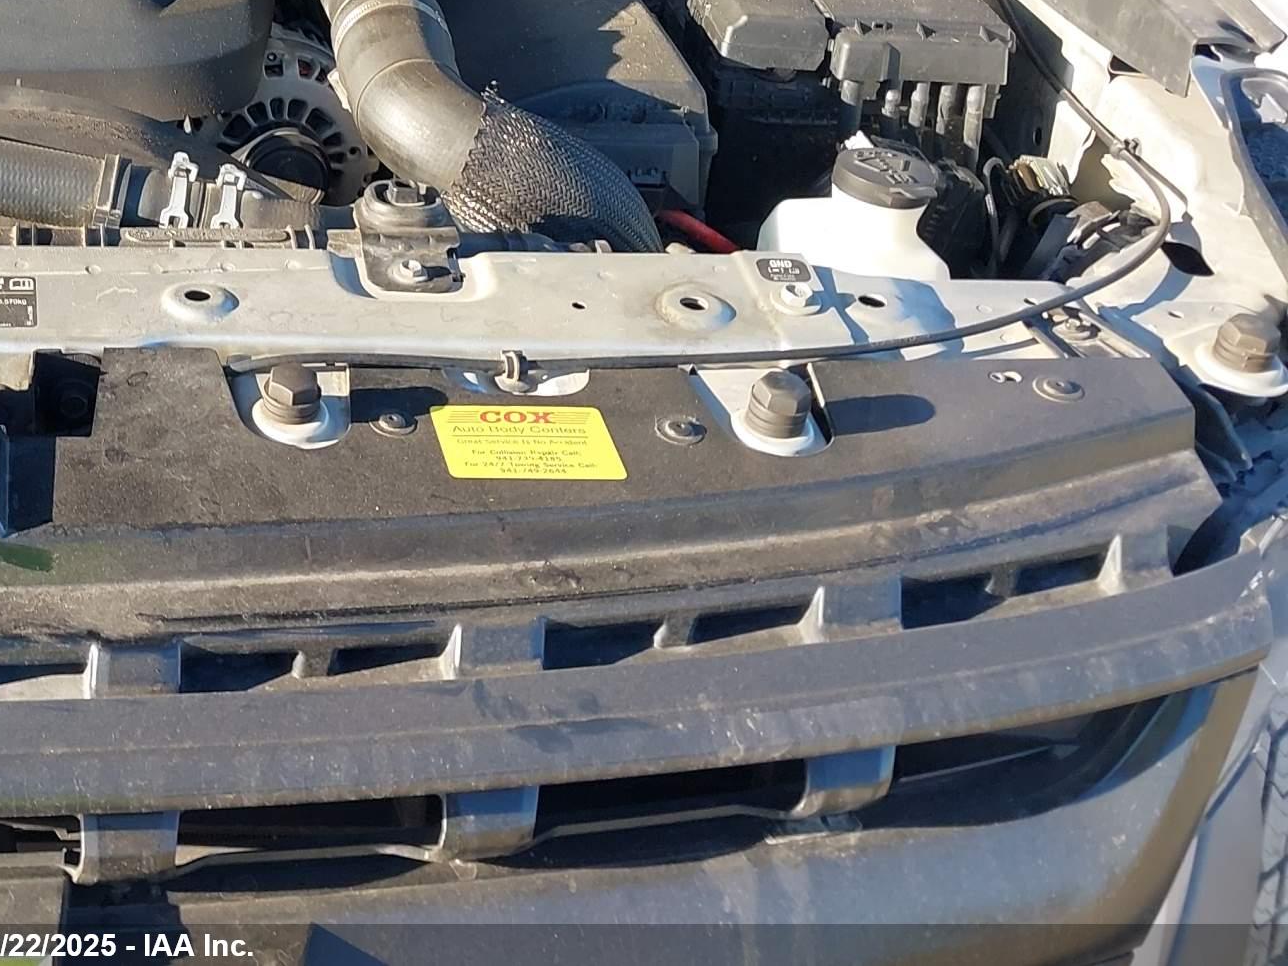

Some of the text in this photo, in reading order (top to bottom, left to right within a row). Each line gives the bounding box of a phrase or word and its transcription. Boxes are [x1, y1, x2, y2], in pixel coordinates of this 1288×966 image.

[769, 260, 793, 268] GND
[479, 411, 556, 424] COX
[453, 425, 587, 435] Auto Body Centers
